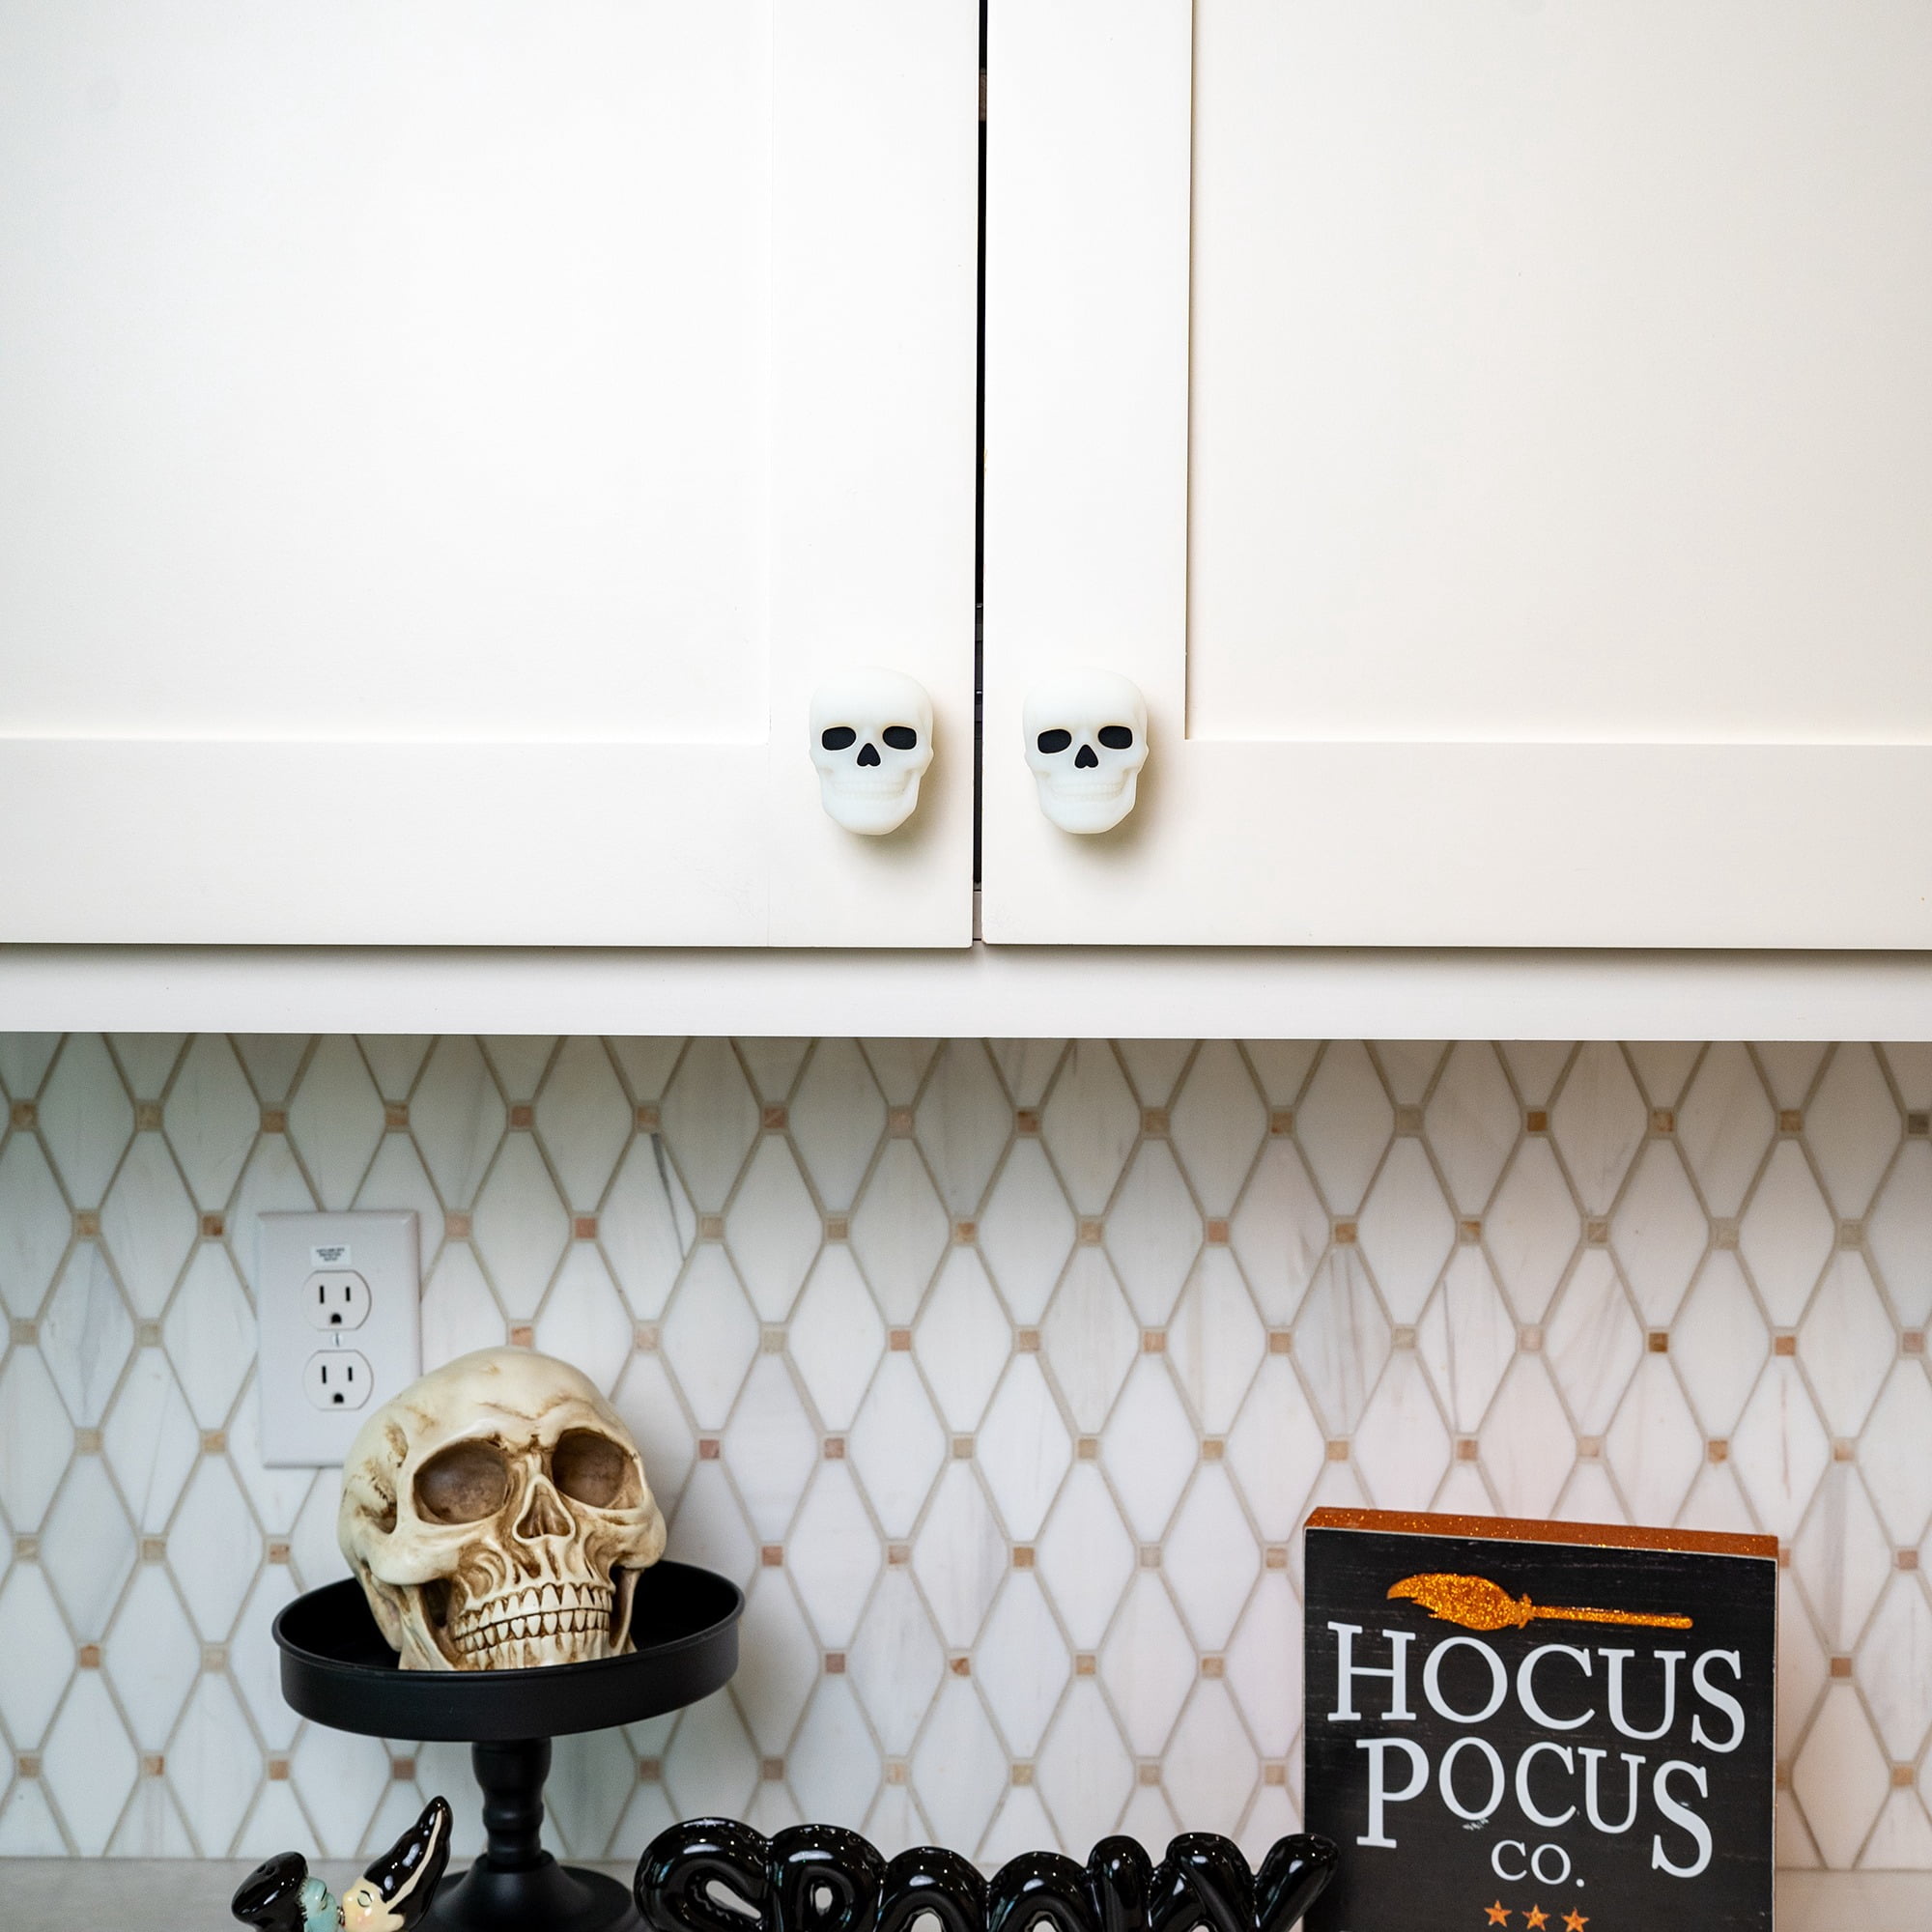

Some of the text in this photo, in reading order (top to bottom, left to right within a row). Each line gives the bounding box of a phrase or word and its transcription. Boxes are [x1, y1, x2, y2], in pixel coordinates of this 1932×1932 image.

[1327, 1621, 1746, 1753] HOCUS
[1356, 1737, 1713, 1878] POCUS
[1492, 1839, 1585, 1888] CO.
